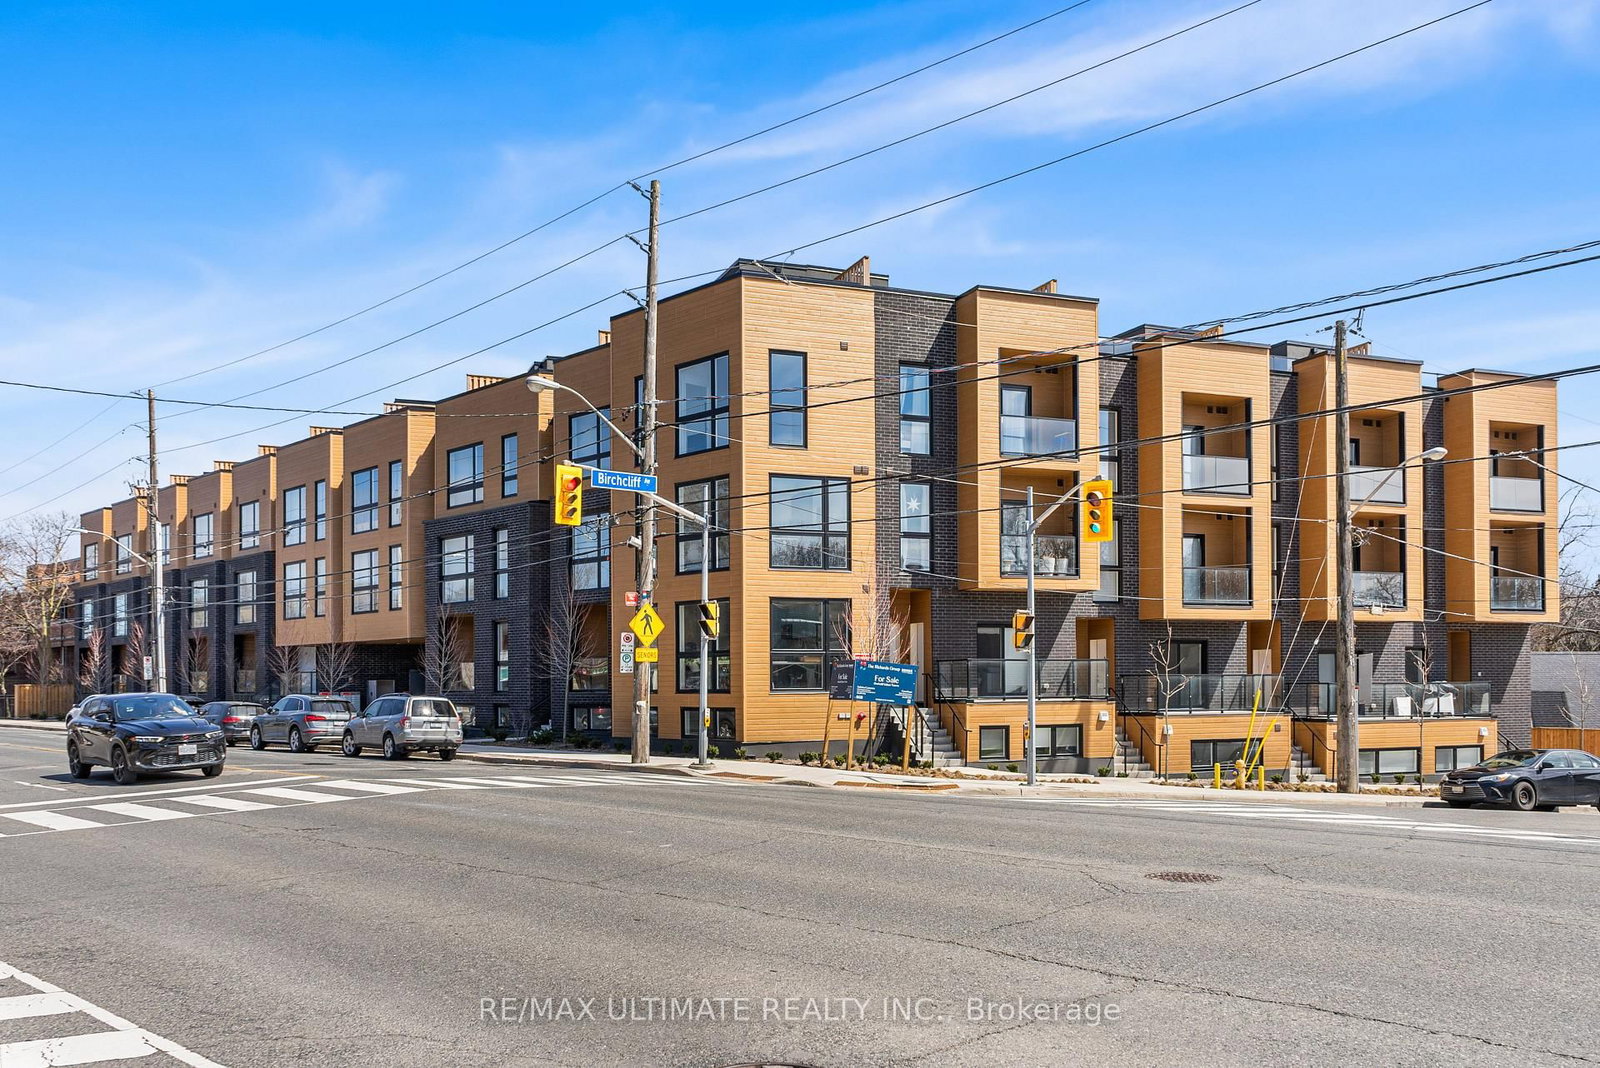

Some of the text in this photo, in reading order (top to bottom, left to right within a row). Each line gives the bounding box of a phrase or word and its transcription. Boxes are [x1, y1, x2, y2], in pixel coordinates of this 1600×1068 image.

[598, 473, 641, 488] Birchcliff
[874, 674, 899, 684] For Sale
